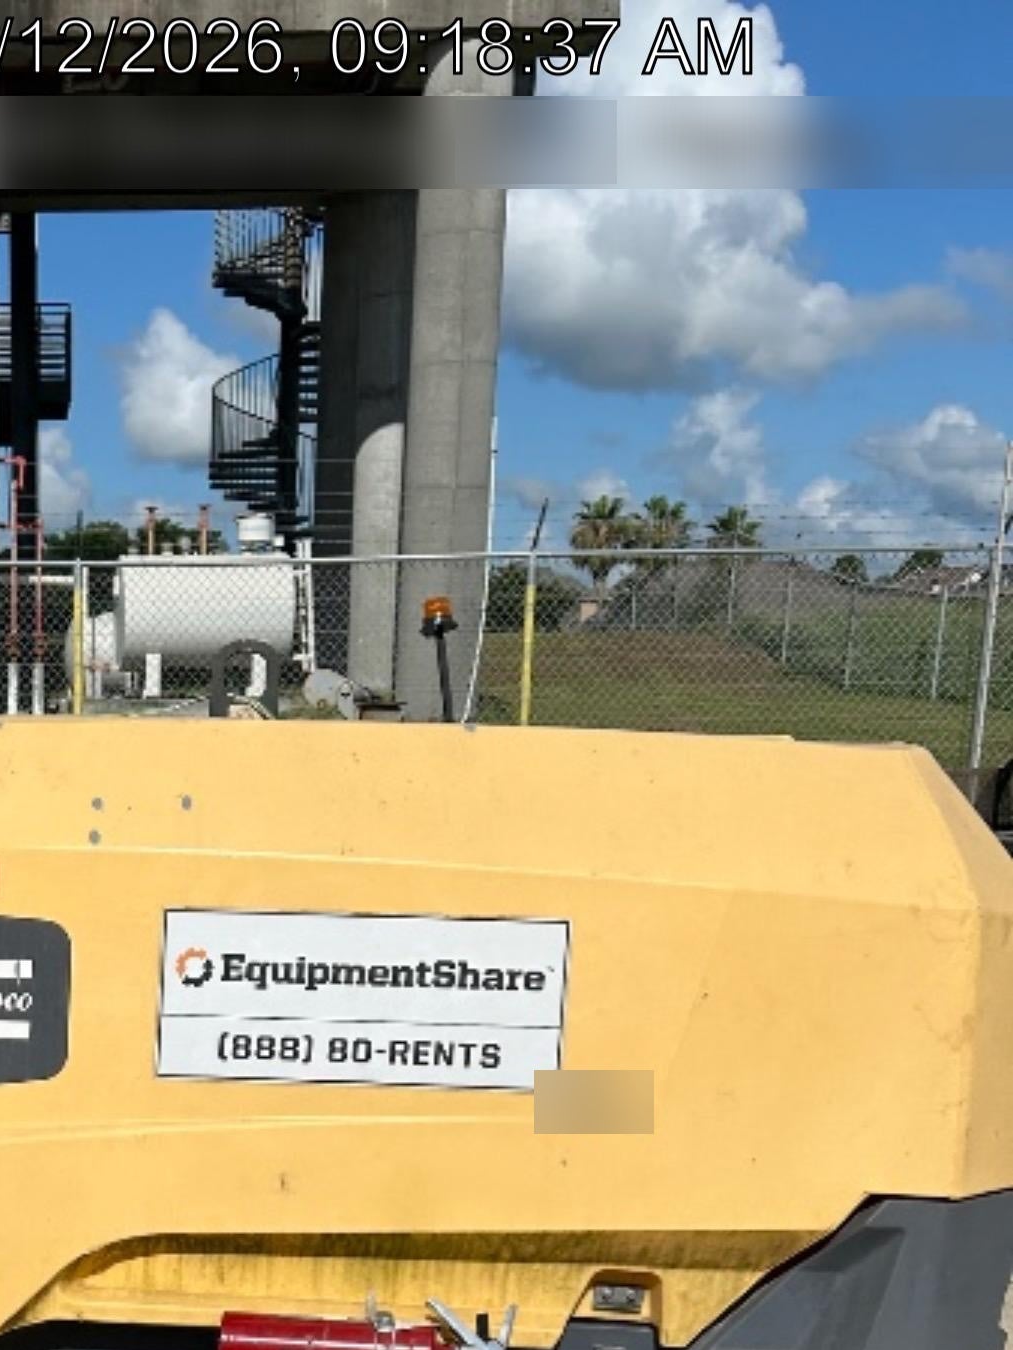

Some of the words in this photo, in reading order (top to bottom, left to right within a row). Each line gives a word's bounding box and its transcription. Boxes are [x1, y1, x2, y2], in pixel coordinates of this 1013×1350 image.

[219, 952, 546, 992] EquipmentShare
[217, 1032, 315, 1064] (888)
[327, 1036, 503, 1069] 80-RENTS
